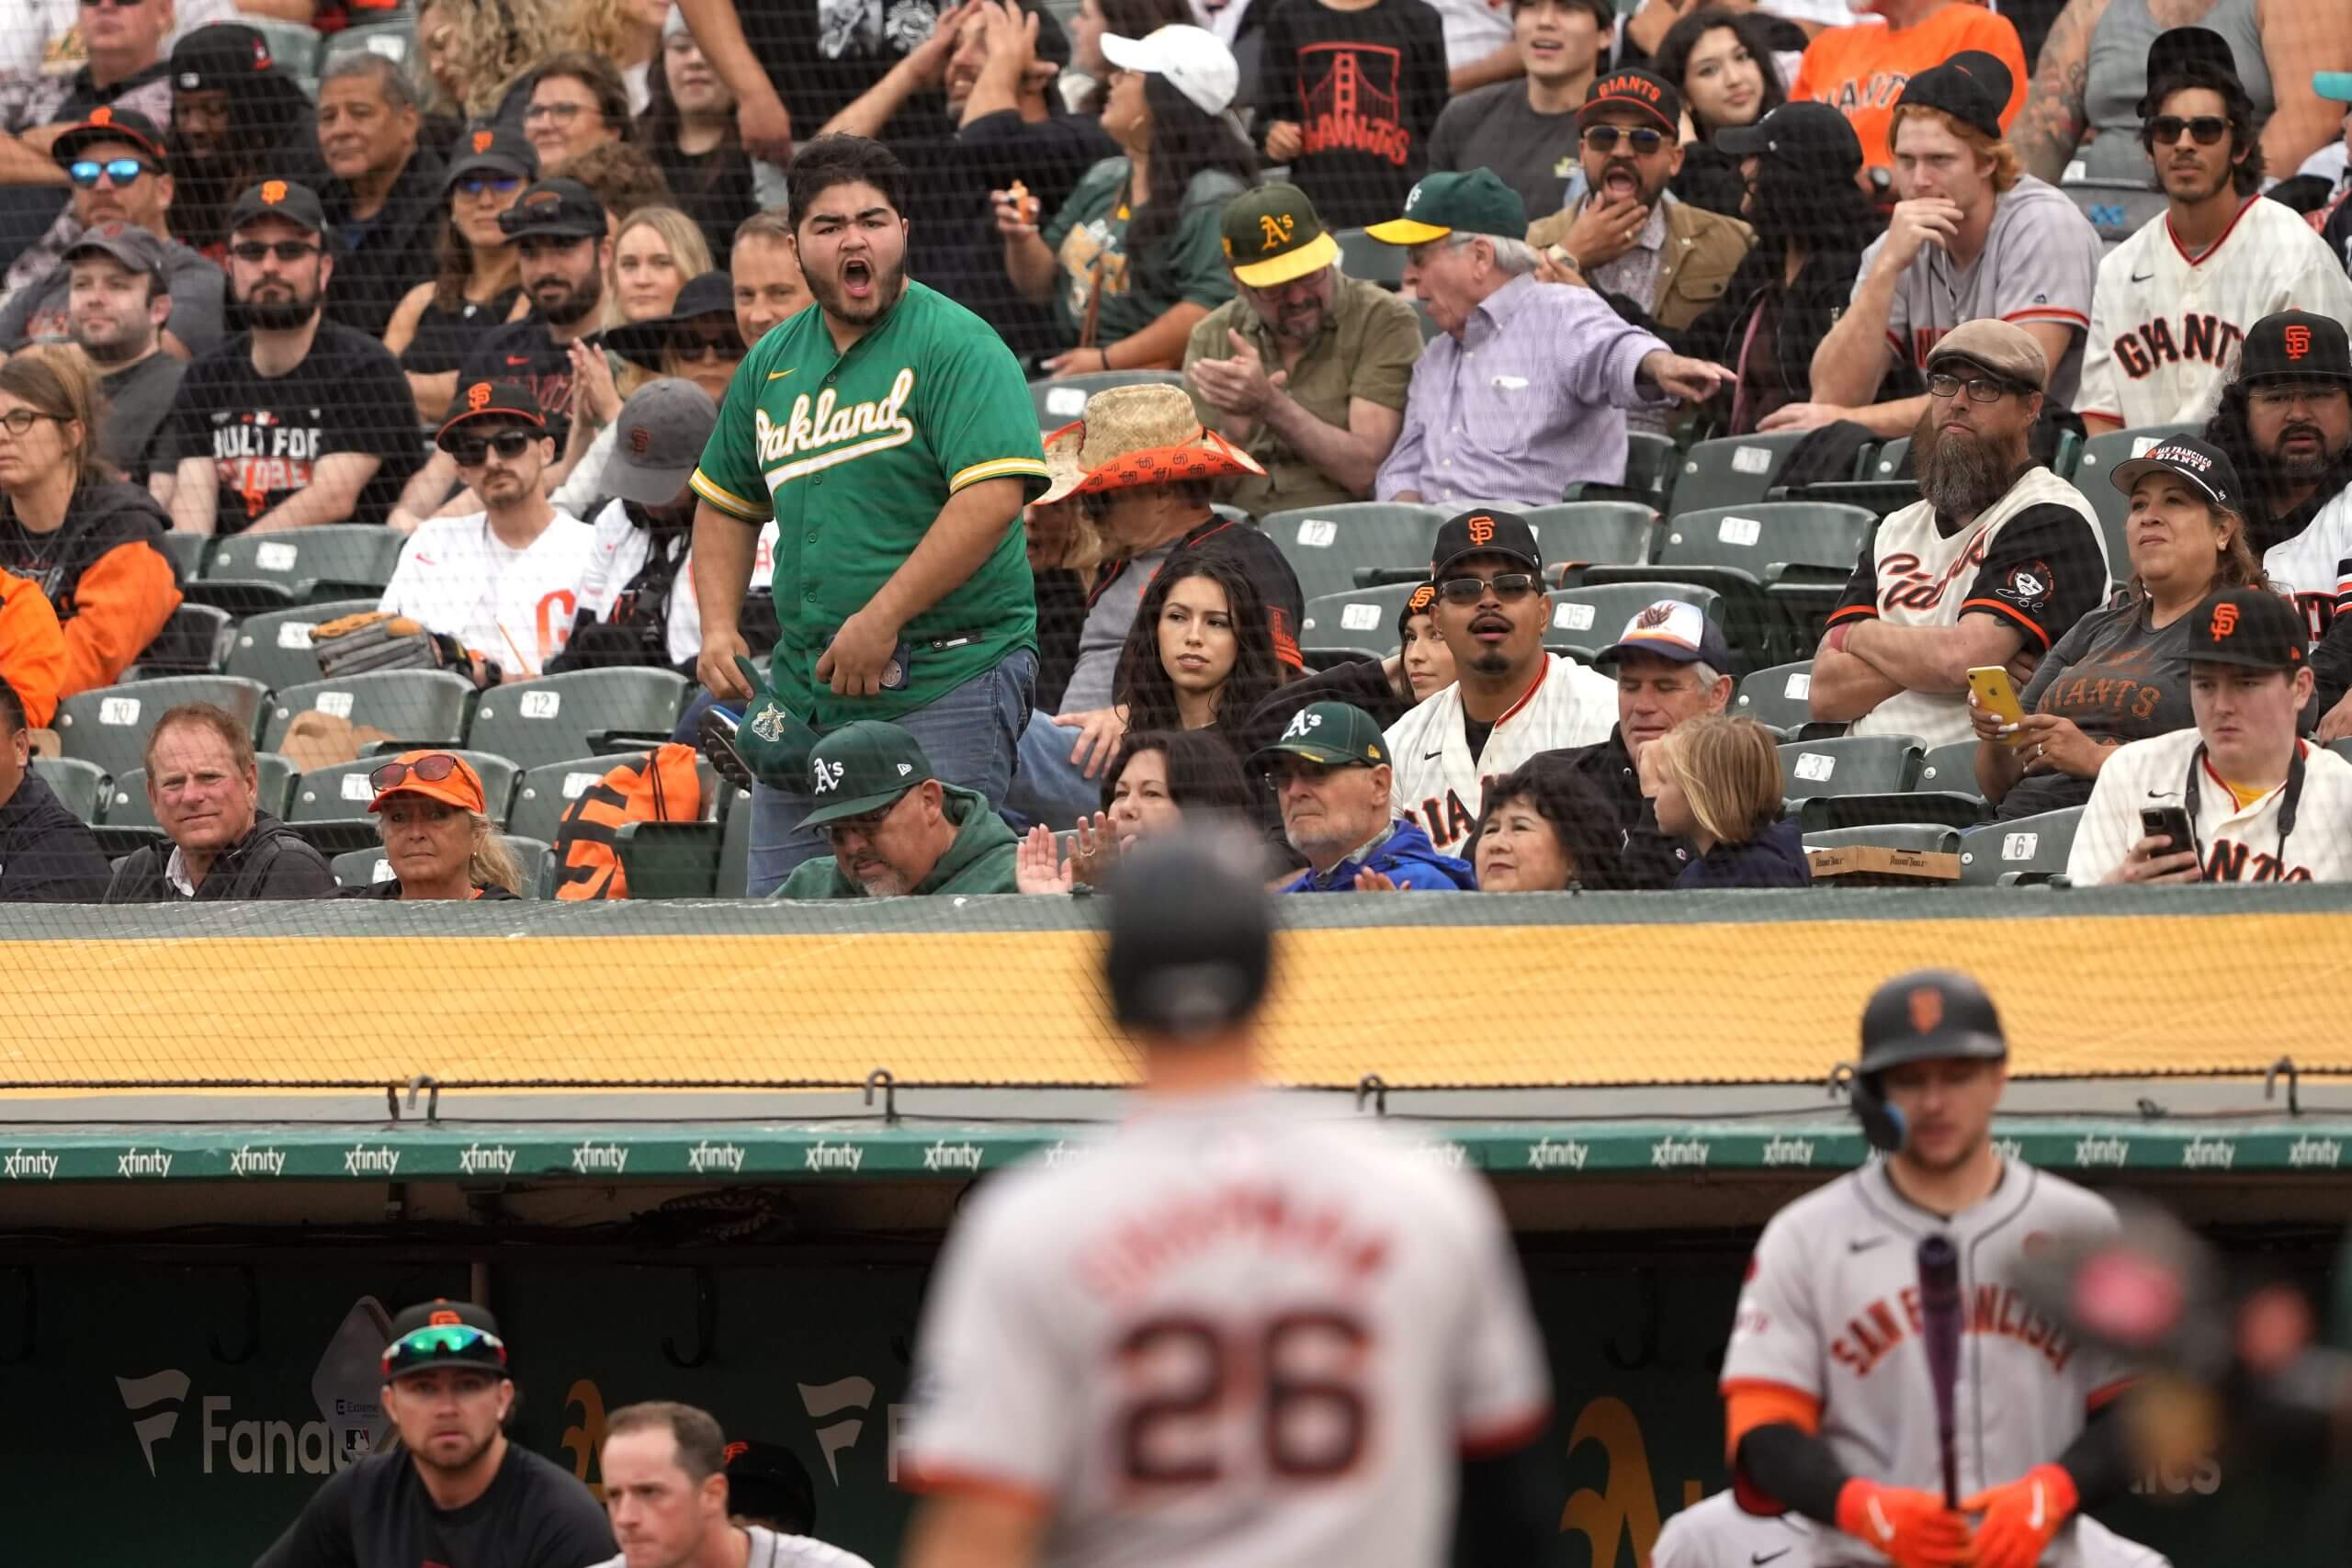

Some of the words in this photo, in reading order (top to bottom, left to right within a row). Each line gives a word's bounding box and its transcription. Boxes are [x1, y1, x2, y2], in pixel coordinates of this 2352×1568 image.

[1599, 76, 1661, 102] GIANTS
[1260, 214, 1295, 250] A's
[2114, 313, 2245, 379] GIANT
[2285, 325, 2311, 361] SF
[469, 382, 492, 412] SF
[756, 367, 913, 470] Oakland
[2155, 454, 2206, 472] GIANTS
[2173, 446, 2212, 467] FRANCISCO
[1467, 516, 1495, 546] SF
[2208, 603, 2239, 642] SF
[112, 703, 132, 724] 10
[532, 694, 550, 713] 12
[1281, 709, 1322, 741] A's
[814, 758, 844, 796] A's
[1807, 755, 1821, 777] 3
[2013, 835, 2024, 857] 6
[5, 1148, 58, 1179] xfinity
[118, 1147, 172, 1178] xfinity
[231, 1145, 286, 1176] xfinity
[345, 1144, 400, 1176] xfinity
[460, 1142, 515, 1174] xfinity
[572, 1139, 628, 1173] xfinity
[689, 1139, 745, 1173] xfinity
[805, 1139, 863, 1171] xfinity
[923, 1139, 984, 1171] xfinity
[1528, 1134, 1589, 1169] xfinity
[1652, 1134, 1710, 1168] xfinity
[1762, 1134, 1815, 1167] xfinity
[2075, 1133, 2130, 1168] xfinity
[2182, 1132, 2236, 1169] xfinity
[2289, 1133, 2343, 1168] xfinity
[1118, 1309, 1372, 1484] 26
